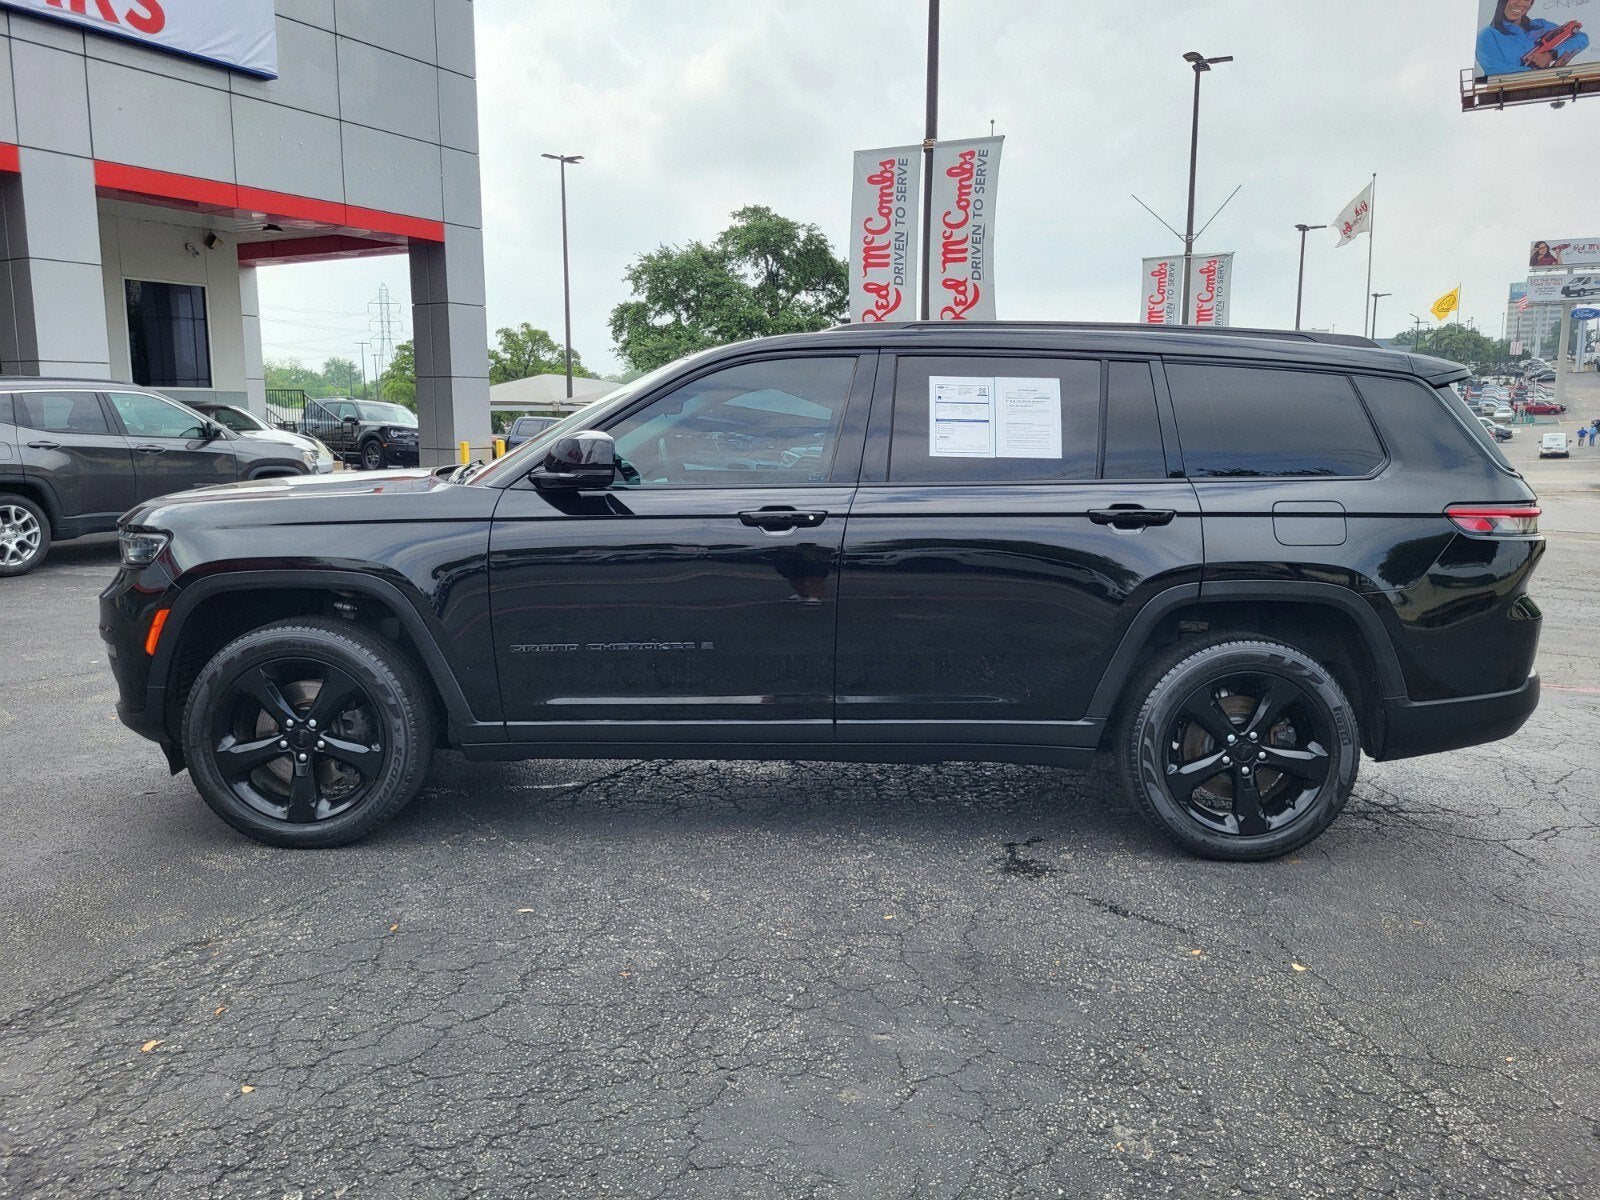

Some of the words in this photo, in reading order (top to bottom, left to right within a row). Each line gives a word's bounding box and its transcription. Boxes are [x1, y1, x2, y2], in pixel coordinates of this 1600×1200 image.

[896, 157, 909, 203] SERVE
[974, 149, 989, 195] SERVE
[862, 158, 896, 278] McCombs
[895, 207, 906, 227] TO
[941, 149, 976, 274] McCombs
[972, 198, 984, 220] TO
[894, 231, 905, 286] DRIVEN
[971, 224, 983, 281] DRIVEN
[1217, 259, 1225, 285] SERVE
[1168, 261, 1176, 287] SERVE
[1196, 259, 1217, 325] McCombs
[1216, 286, 1223, 298] TO
[862, 282, 902, 322] Red
[940, 277, 980, 320] Red
[1167, 289, 1174, 301] TO
[1574, 308, 1595, 318] Ford
[510, 643, 580, 653] GRAND
[586, 641, 696, 651] CHEROKEE
